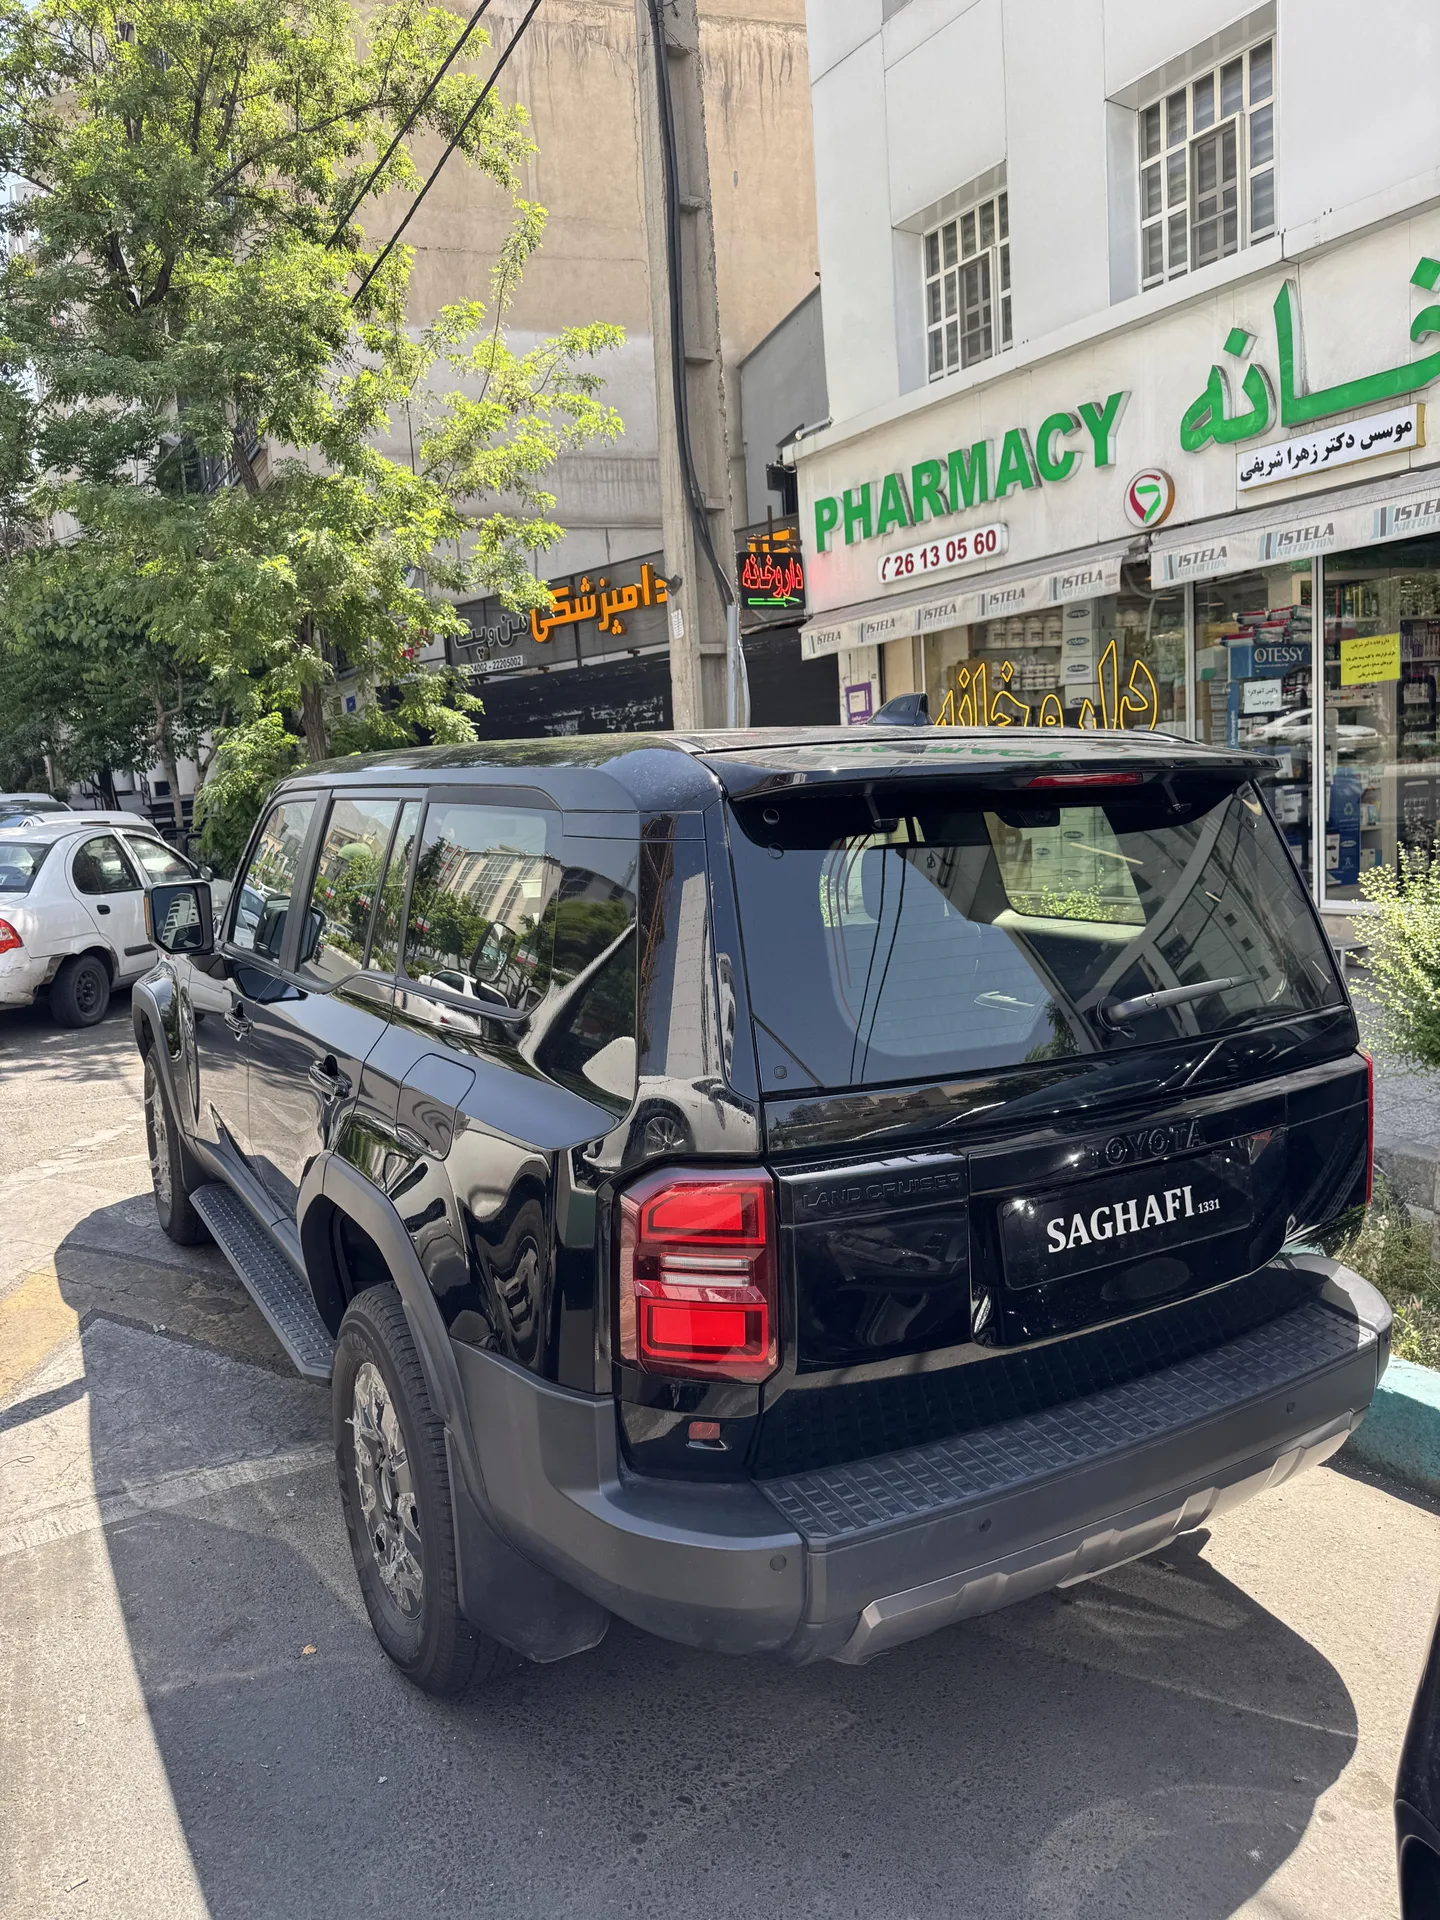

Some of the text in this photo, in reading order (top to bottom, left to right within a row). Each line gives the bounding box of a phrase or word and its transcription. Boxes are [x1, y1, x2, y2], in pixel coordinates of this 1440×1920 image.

[1240, 421, 1412, 481] موسس دکتر زهرا شریفی
[815, 391, 1130, 553] PHARMACY
[1278, 523, 1334, 546] ISTELA
[894, 529, 997, 577] 26 13 05 60
[1178, 546, 1228, 567] ISTELA
[742, 554, 803, 597] داروخانه
[1061, 569, 1103, 590] ISTELA
[989, 588, 1025, 606] ISTELA
[924, 604, 957, 620] ISTELA
[866, 618, 896, 634] ISTELA
[816, 631, 842, 645] ISTELA
[1254, 646, 1305, 663] OTESSY
[1082, 1119, 1207, 1168] TOYOTA
[803, 1172, 961, 1208] LAND CRUISER
[1047, 1185, 1221, 1253] SAGHAFI 1331
